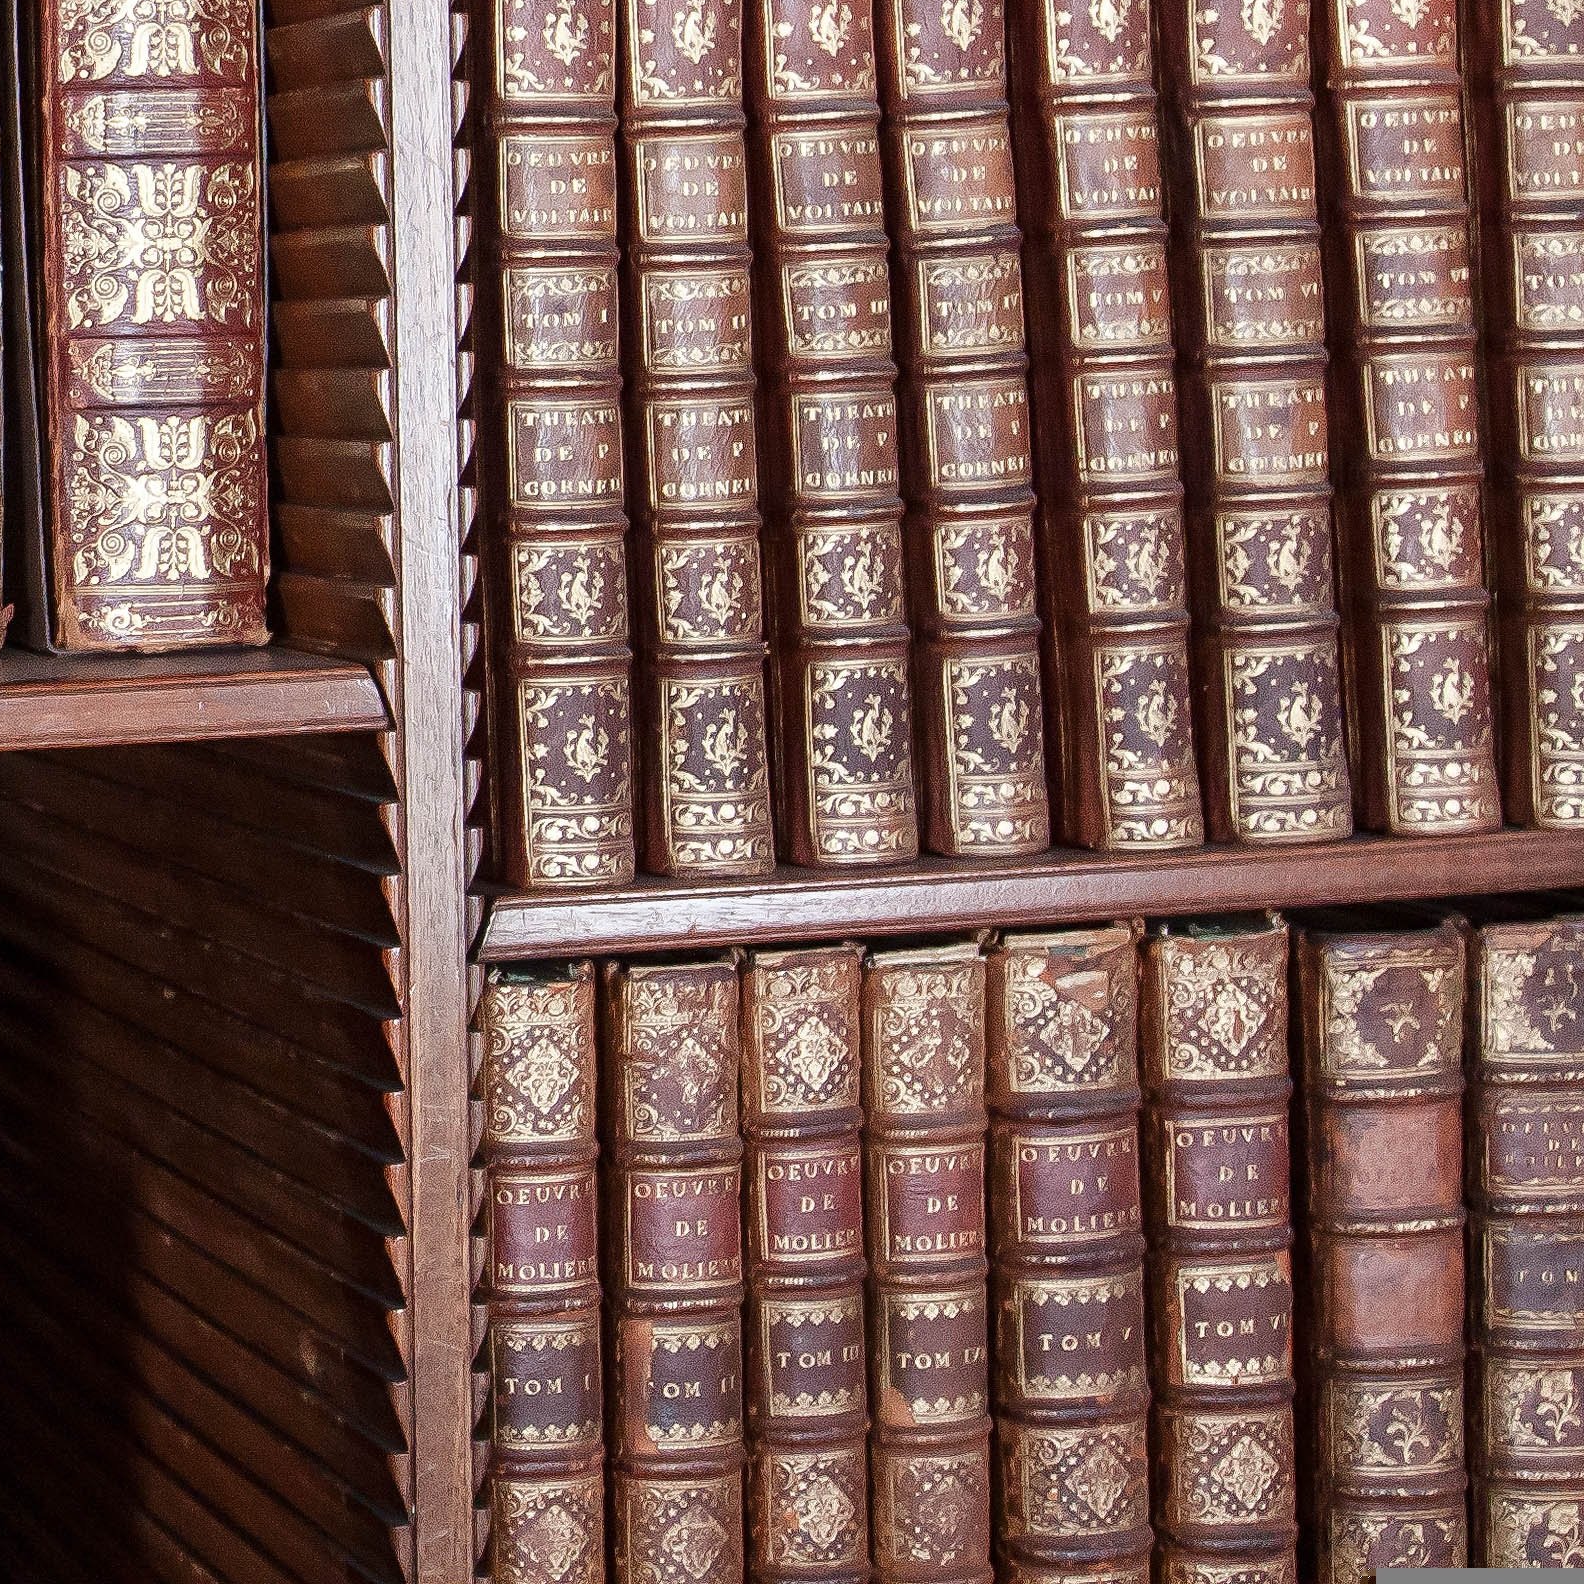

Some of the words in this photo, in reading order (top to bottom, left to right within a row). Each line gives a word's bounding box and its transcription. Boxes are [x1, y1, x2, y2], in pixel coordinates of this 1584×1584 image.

[1403, 139, 1436, 153] DE
[1104, 156, 1136, 171] DE
[1252, 156, 1286, 171] DE
[824, 171, 856, 186] DE
[953, 166, 986, 182] DE
[550, 178, 586, 194] DE
[682, 182, 718, 196] DE
[1378, 271, 1436, 285] TOM
[1526, 274, 1584, 288] TOM
[1090, 290, 1144, 305] TOM
[1224, 288, 1284, 302] TOM
[798, 304, 856, 318] TOM
[937, 300, 991, 314] TOM
[522, 312, 580, 328] TOM
[656, 319, 716, 332] TOM
[1220, 1164, 1258, 1181] DE
[1070, 1178, 1108, 1194] DE
[801, 1194, 834, 1212] DE
[928, 1196, 958, 1212] DE
[536, 1225, 567, 1242] DE
[676, 1220, 708, 1237] DE
[1196, 1320, 1256, 1337] TOM
[1040, 1333, 1100, 1350] TOM
[777, 1352, 831, 1368] TOM
[900, 1352, 950, 1368] TOM
[505, 1378, 562, 1394] TOM
